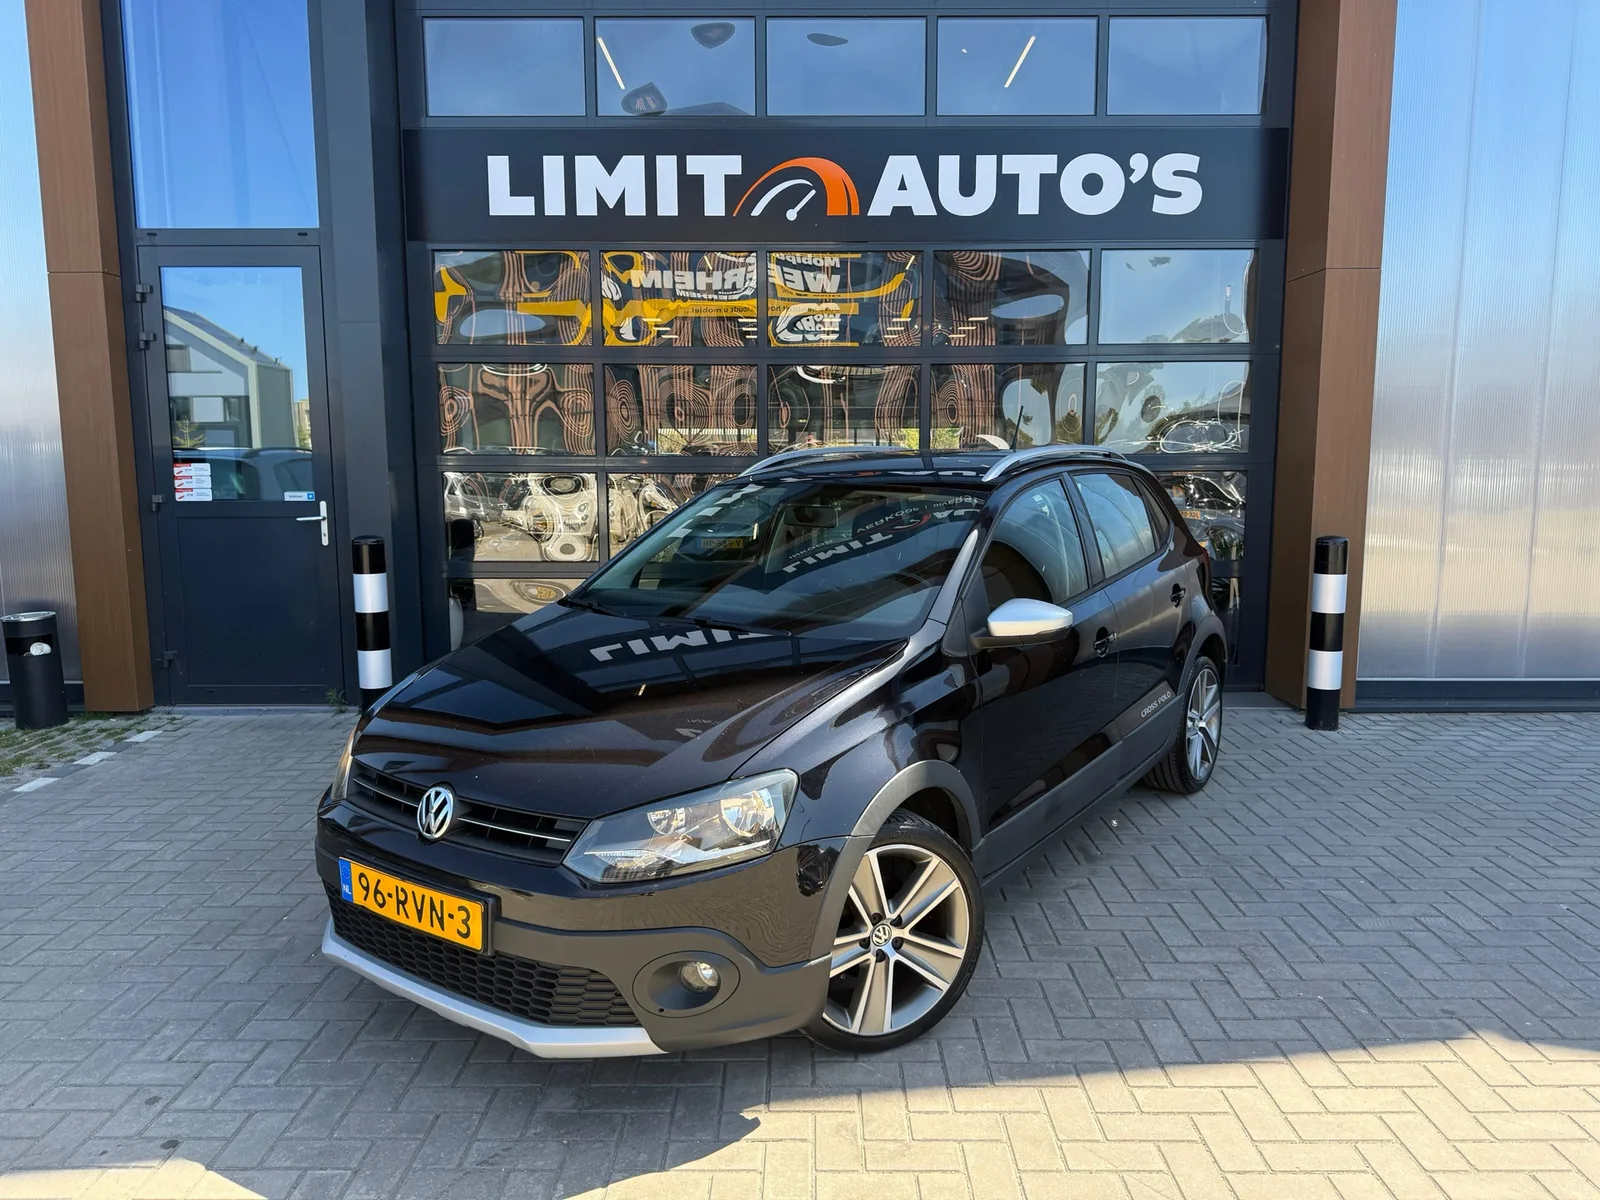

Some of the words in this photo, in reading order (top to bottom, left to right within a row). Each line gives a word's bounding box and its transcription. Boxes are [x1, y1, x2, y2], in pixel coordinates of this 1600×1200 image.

[487, 154, 742, 217] LIMIT
[867, 152, 1203, 217] AUTO'S
[1140, 700, 1158, 718] CROSS
[1157, 691, 1172, 705] POLO
[342, 883, 352, 895] NL
[357, 871, 471, 939] 96-RVN-3
